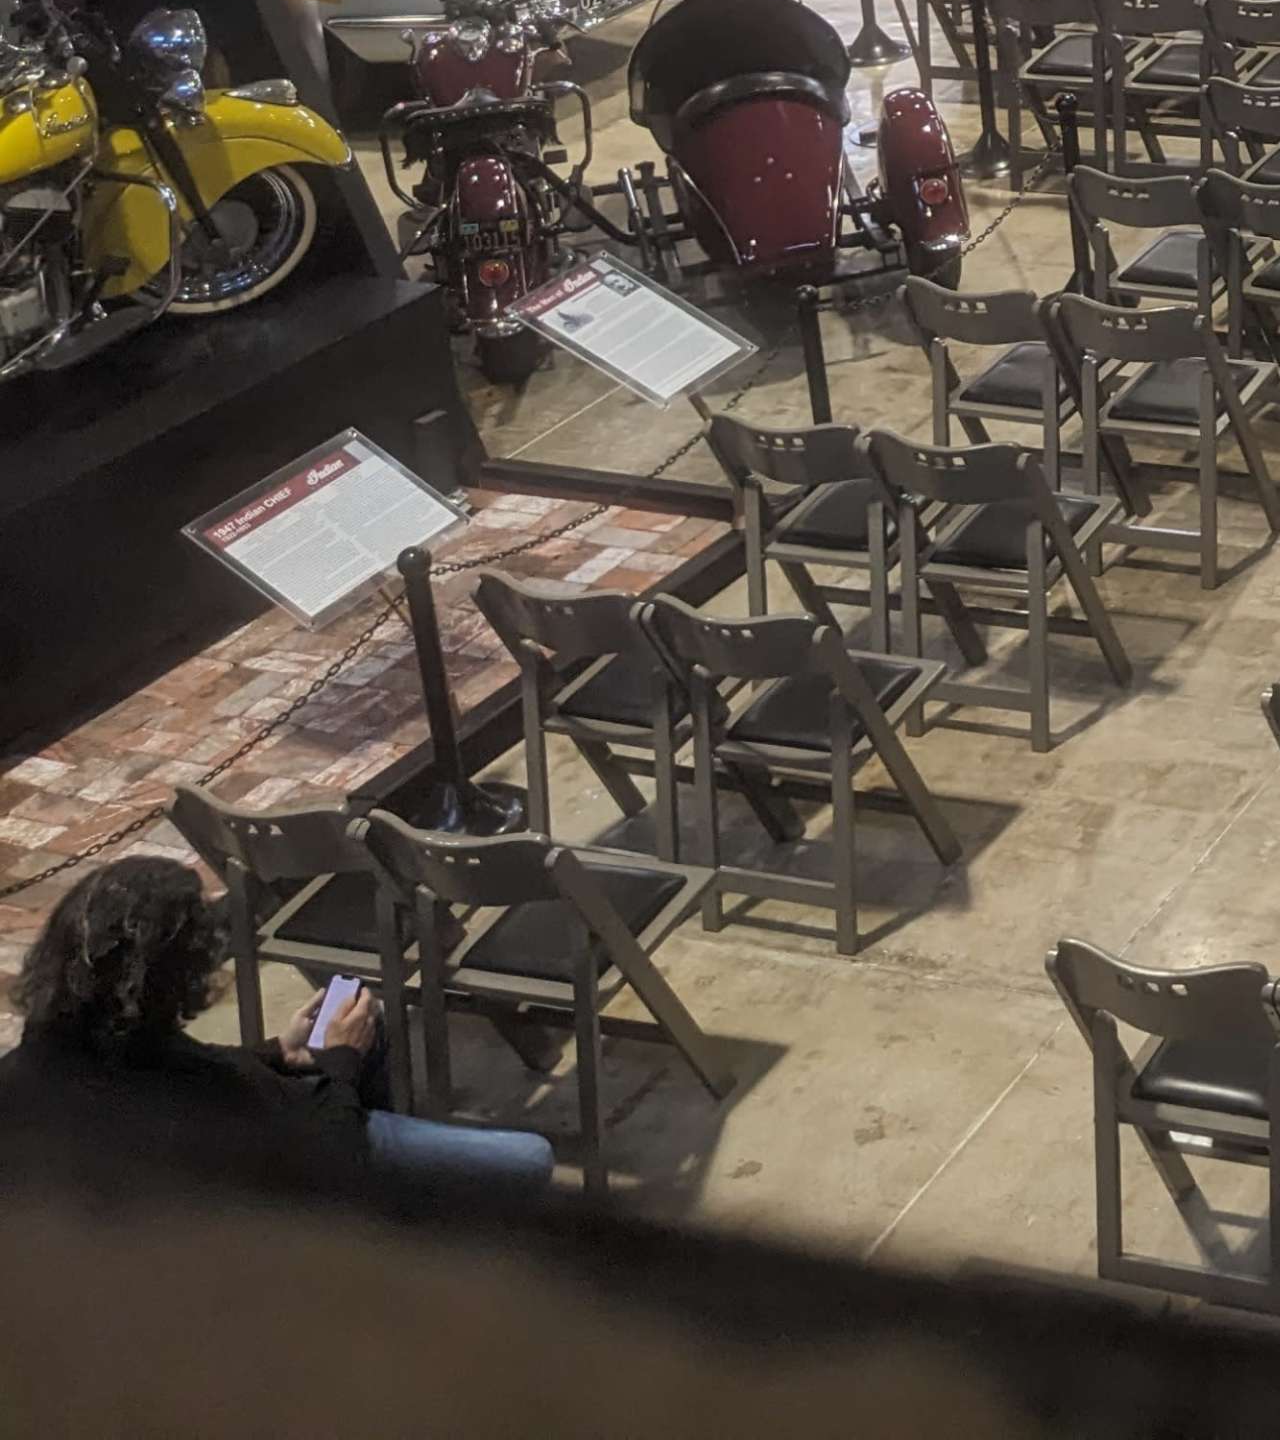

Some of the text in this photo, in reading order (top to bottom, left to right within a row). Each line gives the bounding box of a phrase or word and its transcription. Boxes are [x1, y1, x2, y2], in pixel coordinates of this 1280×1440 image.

[213, 487, 292, 538] 1947 Indian CHIEF
